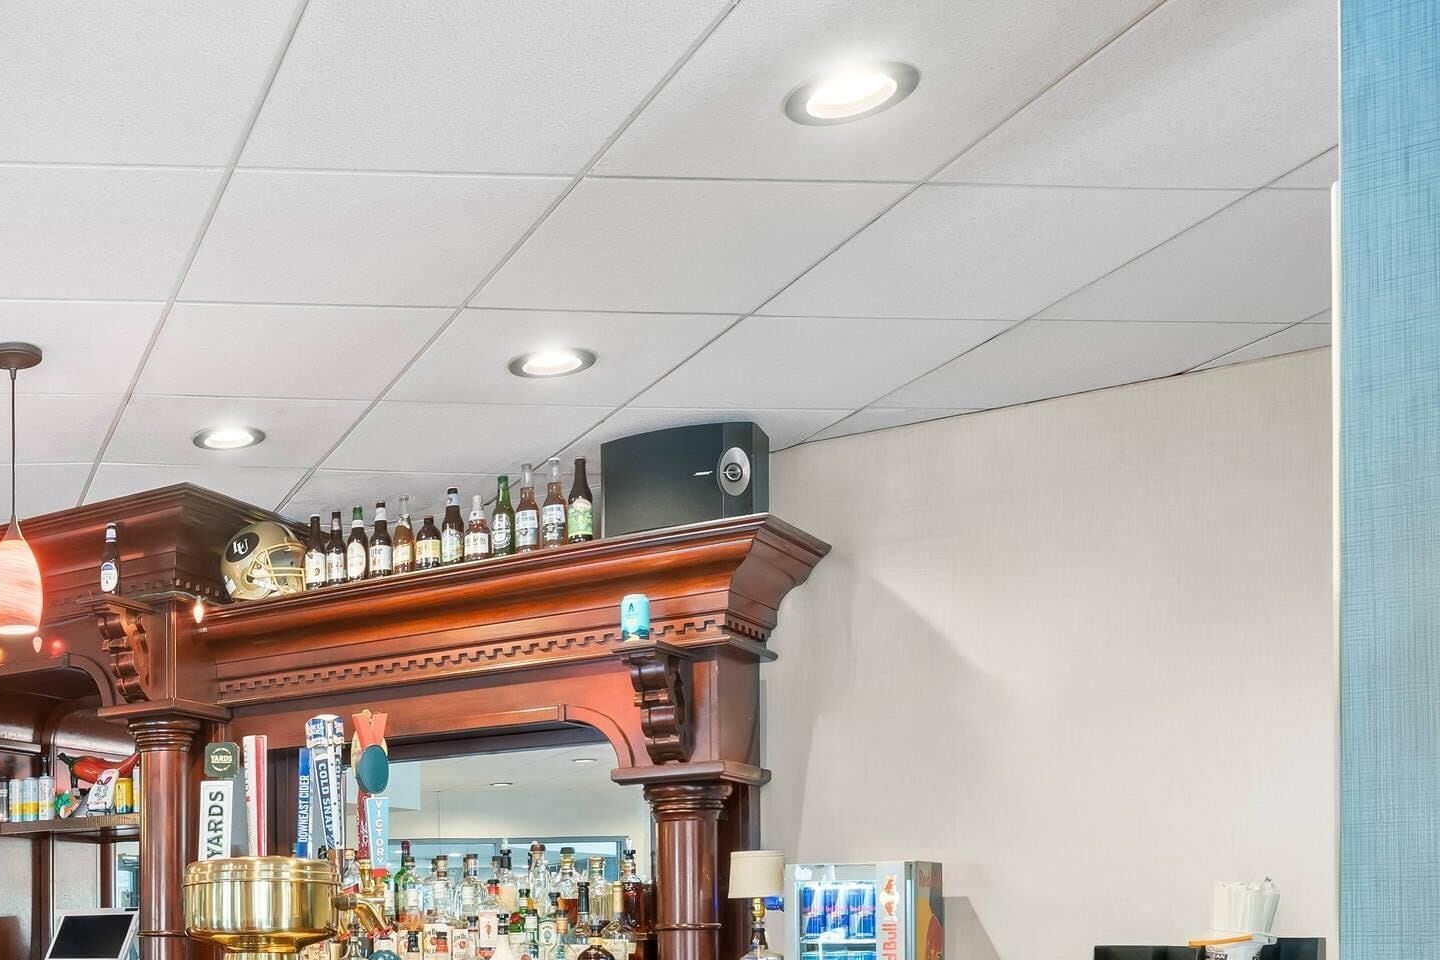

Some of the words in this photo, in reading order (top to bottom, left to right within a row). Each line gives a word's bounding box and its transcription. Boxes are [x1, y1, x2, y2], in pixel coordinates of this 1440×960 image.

[211, 754, 233, 763] YARDS
[299, 775, 310, 798] CIDER
[318, 762, 331, 796] COLD
[207, 790, 225, 859] YARDS
[298, 799, 311, 842] DOWNEAST
[323, 797, 335, 831] SNAP
[374, 799, 387, 865] VICTORY
